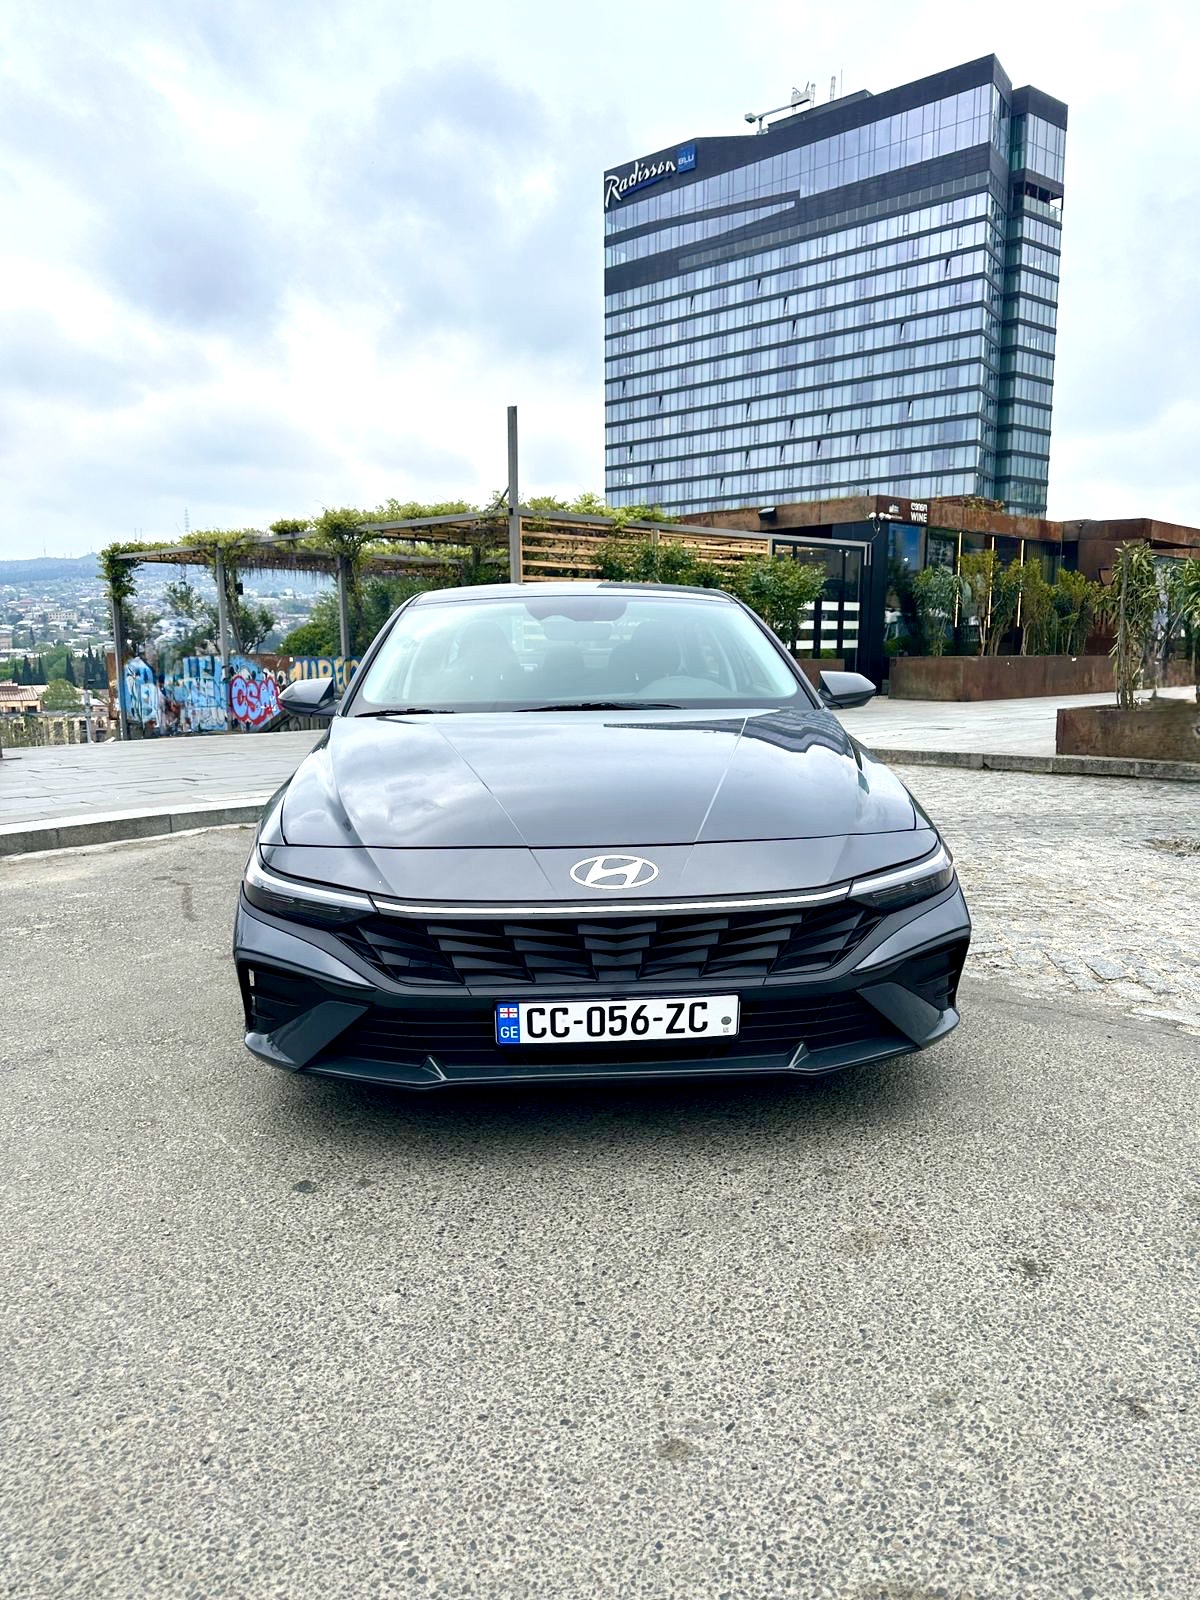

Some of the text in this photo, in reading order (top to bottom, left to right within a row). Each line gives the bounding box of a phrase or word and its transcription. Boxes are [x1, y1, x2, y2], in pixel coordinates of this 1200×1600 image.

[678, 154, 695, 165] BLU
[605, 161, 676, 208] Radisson
[911, 511, 927, 522] WINE
[526, 1001, 709, 1039] CC-056-ZC
[500, 1026, 519, 1039] GE
